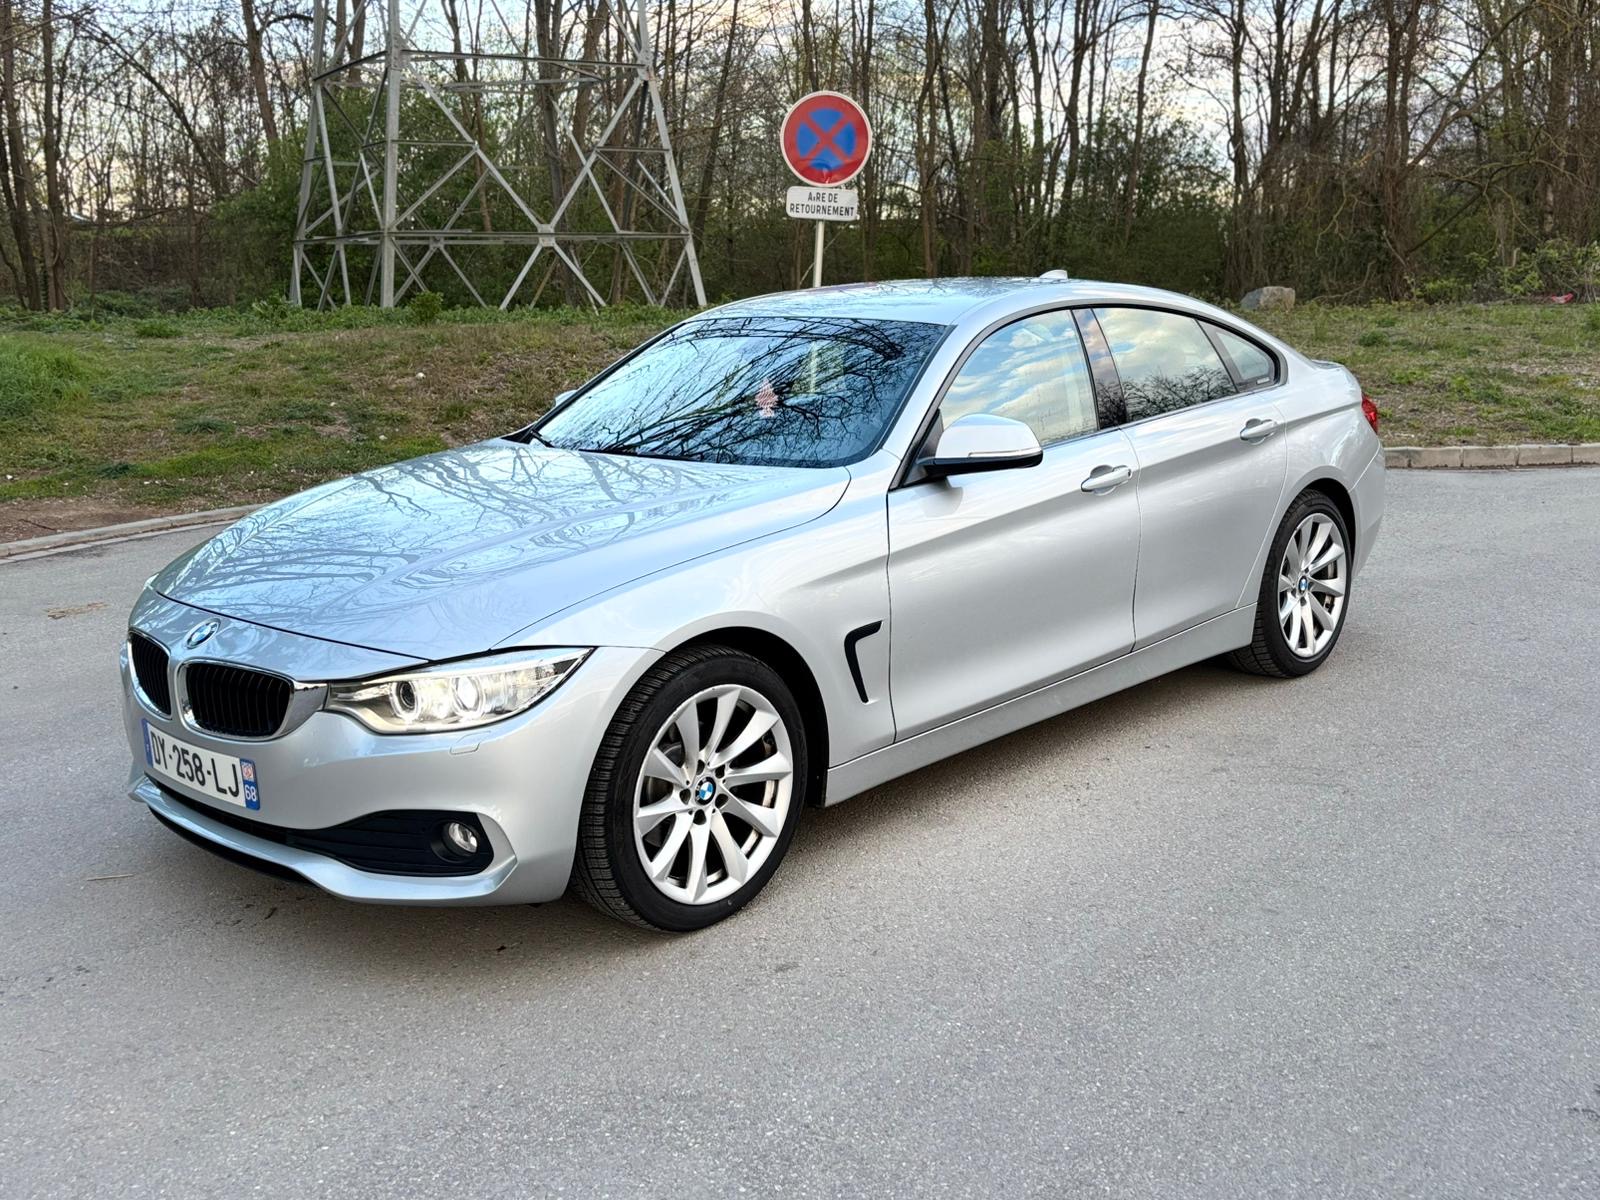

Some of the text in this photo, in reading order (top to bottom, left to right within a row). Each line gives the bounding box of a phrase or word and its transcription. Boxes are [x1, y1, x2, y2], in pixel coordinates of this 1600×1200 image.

[828, 193, 838, 203] DE
[790, 203, 854, 216] RETOURNEMENT
[151, 731, 239, 797] DY-258-LJ
[245, 785, 257, 802] 68
